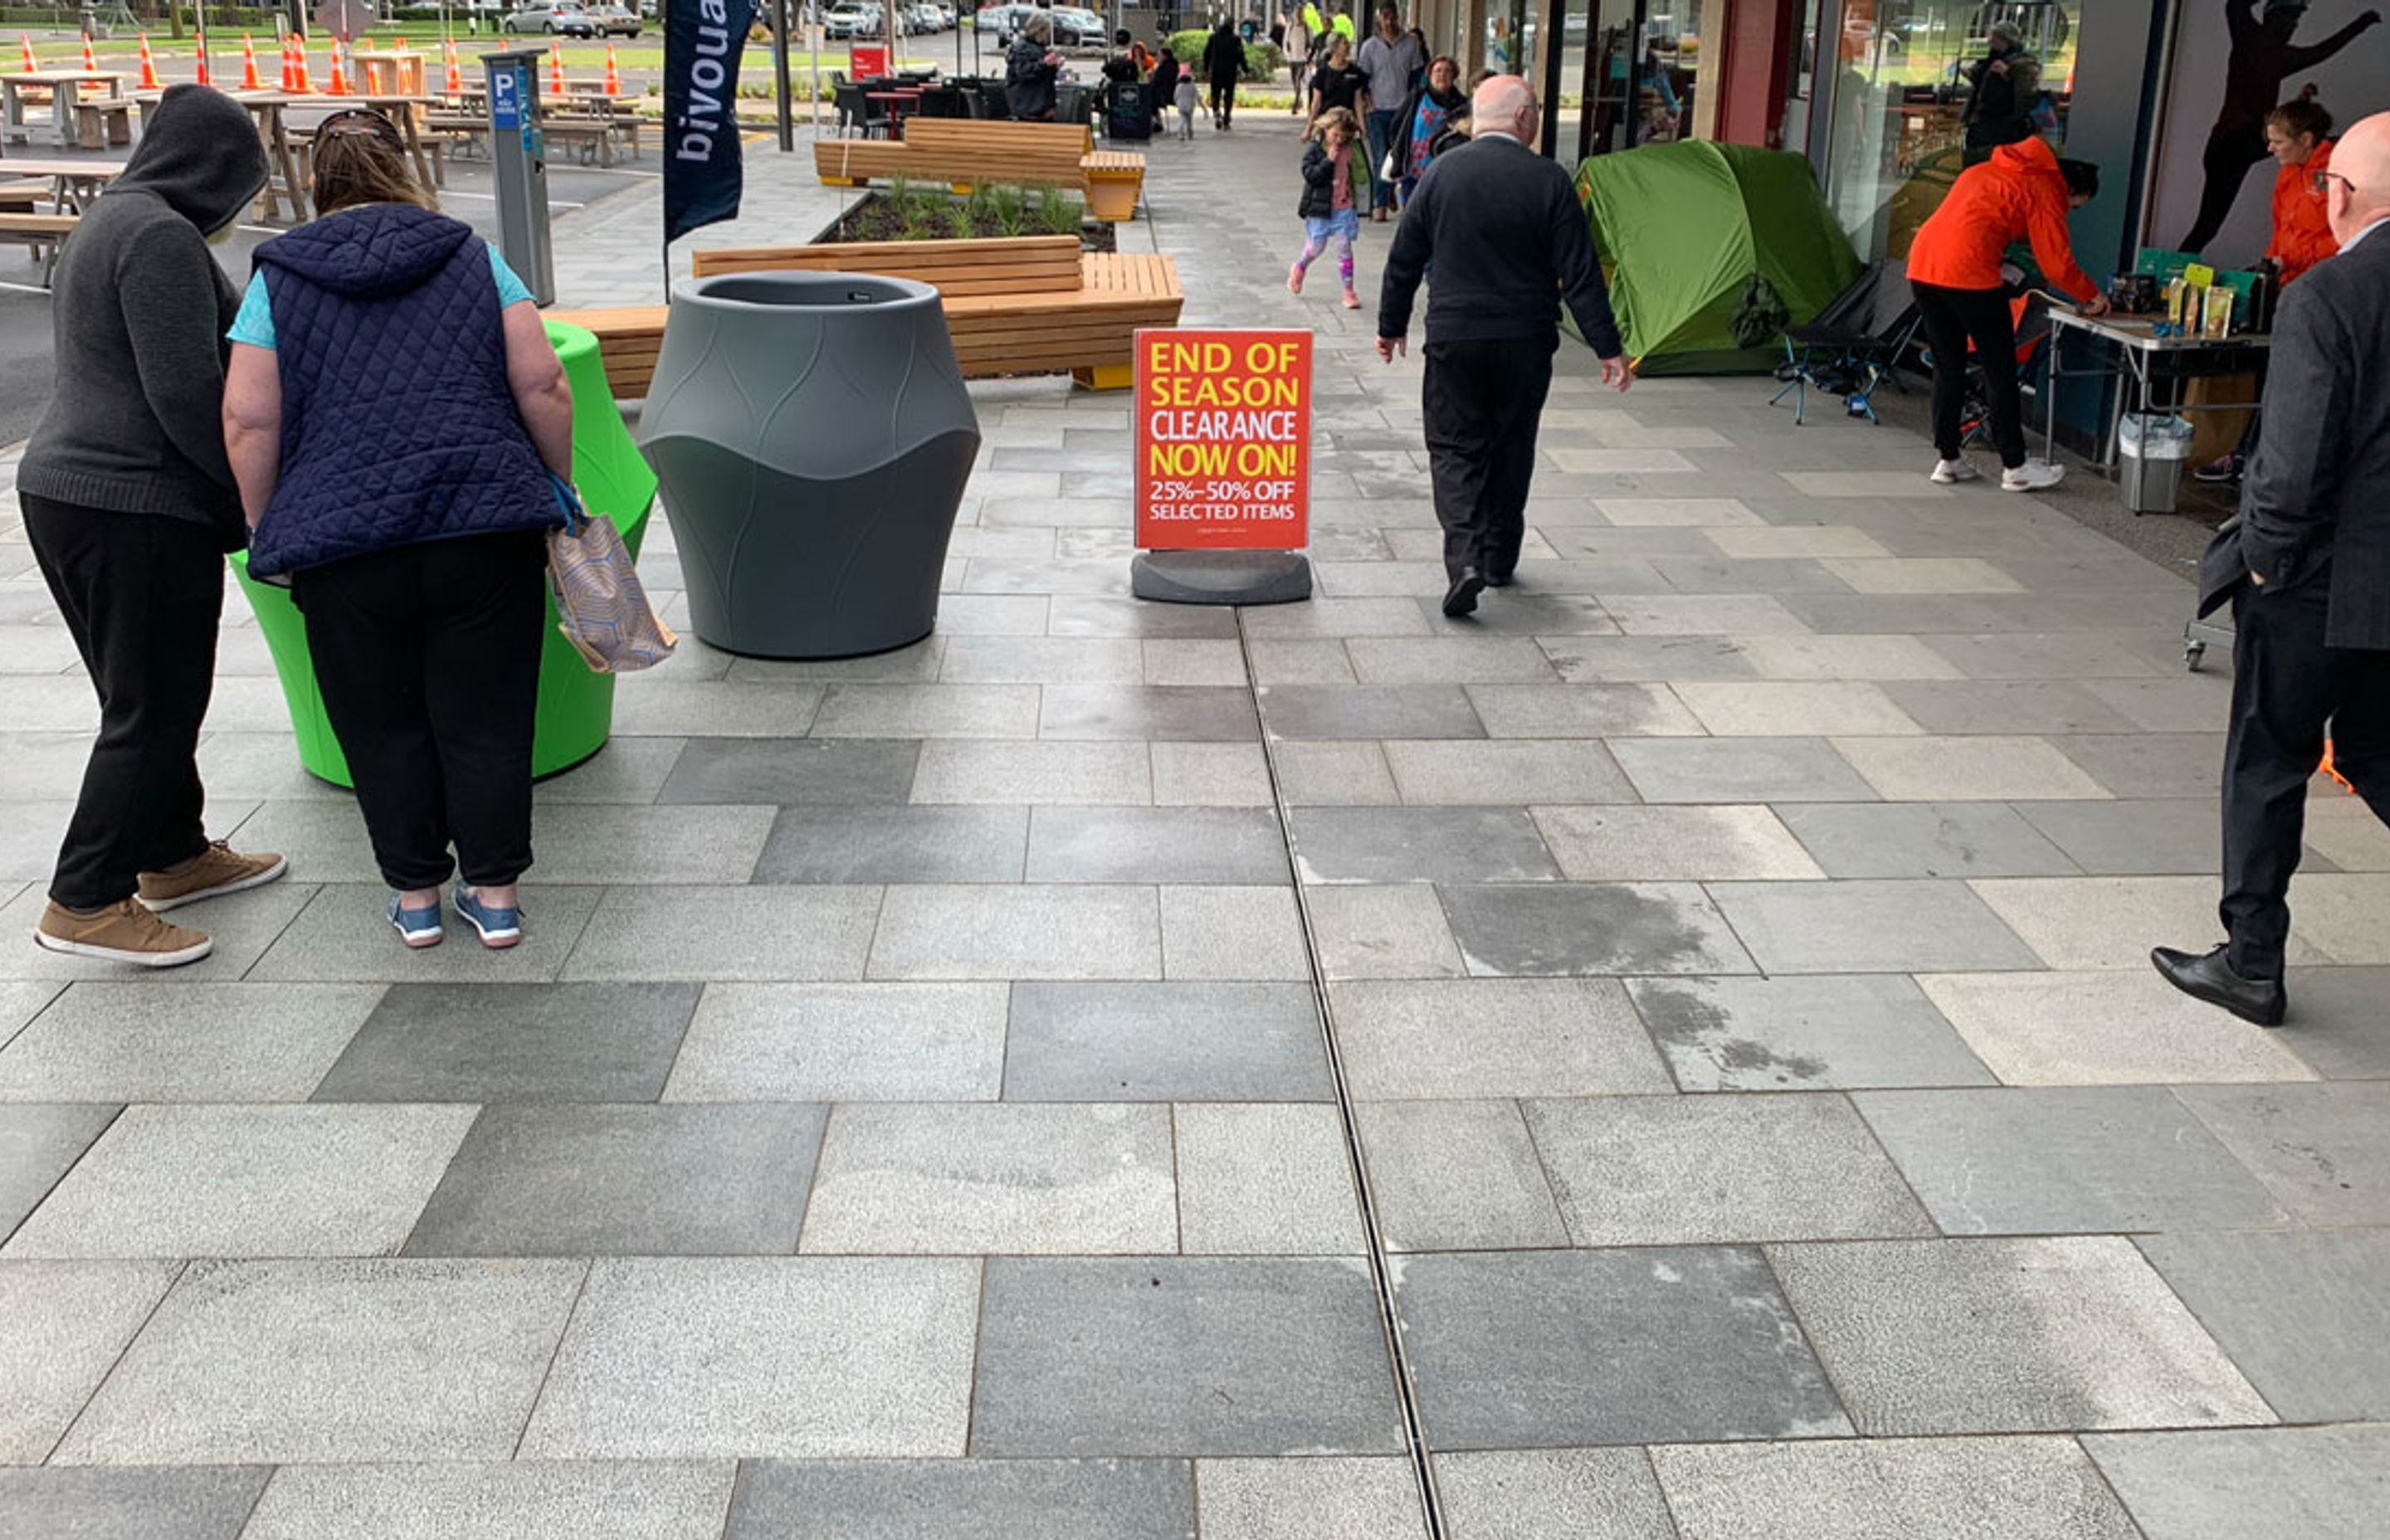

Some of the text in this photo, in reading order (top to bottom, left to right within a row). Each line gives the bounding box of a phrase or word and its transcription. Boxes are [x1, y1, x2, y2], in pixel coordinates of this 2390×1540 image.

[495, 74, 514, 97] P
[1150, 343, 1299, 373] END OF
[1150, 378, 1299, 407] SEASON
[1151, 411, 1296, 441] CLEARANCE
[1150, 444, 1297, 476] NOW ON!
[1254, 481, 1295, 500] OFF
[1150, 504, 1295, 519] SELECTED ITEMS
